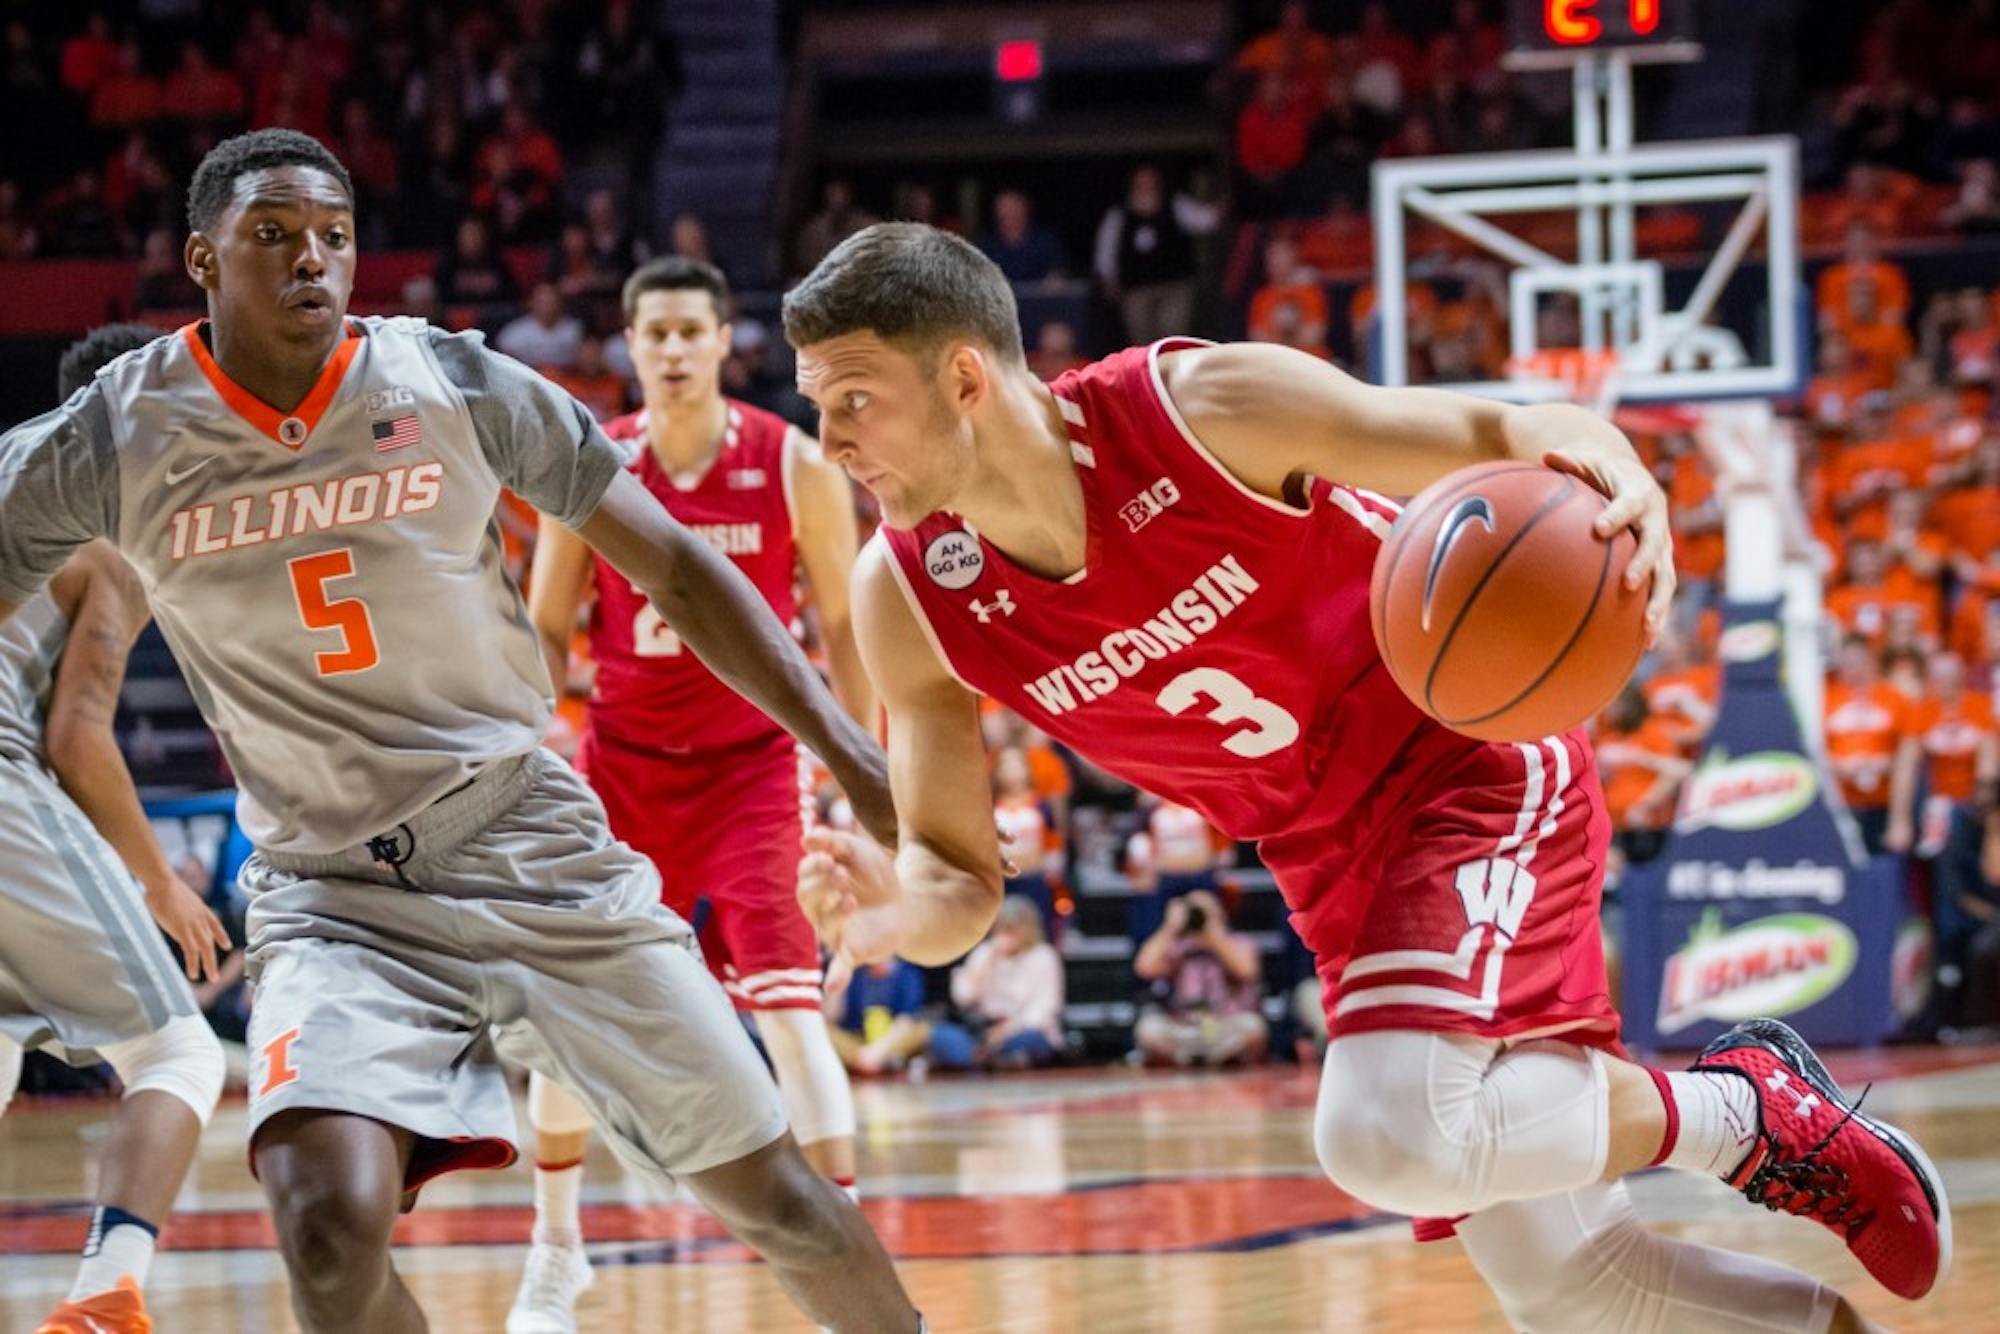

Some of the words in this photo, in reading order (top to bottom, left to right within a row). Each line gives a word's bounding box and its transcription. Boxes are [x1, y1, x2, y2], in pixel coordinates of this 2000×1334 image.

[171, 462, 443, 560] ILLINOIS
[941, 541, 964, 557] AN
[931, 562, 954, 576] GG
[959, 553, 980, 568] KG
[286, 547, 381, 678] 5
[1022, 553, 1260, 716] WISCONSIN
[1155, 666, 1300, 758] 3
[1453, 857, 1537, 941] W
